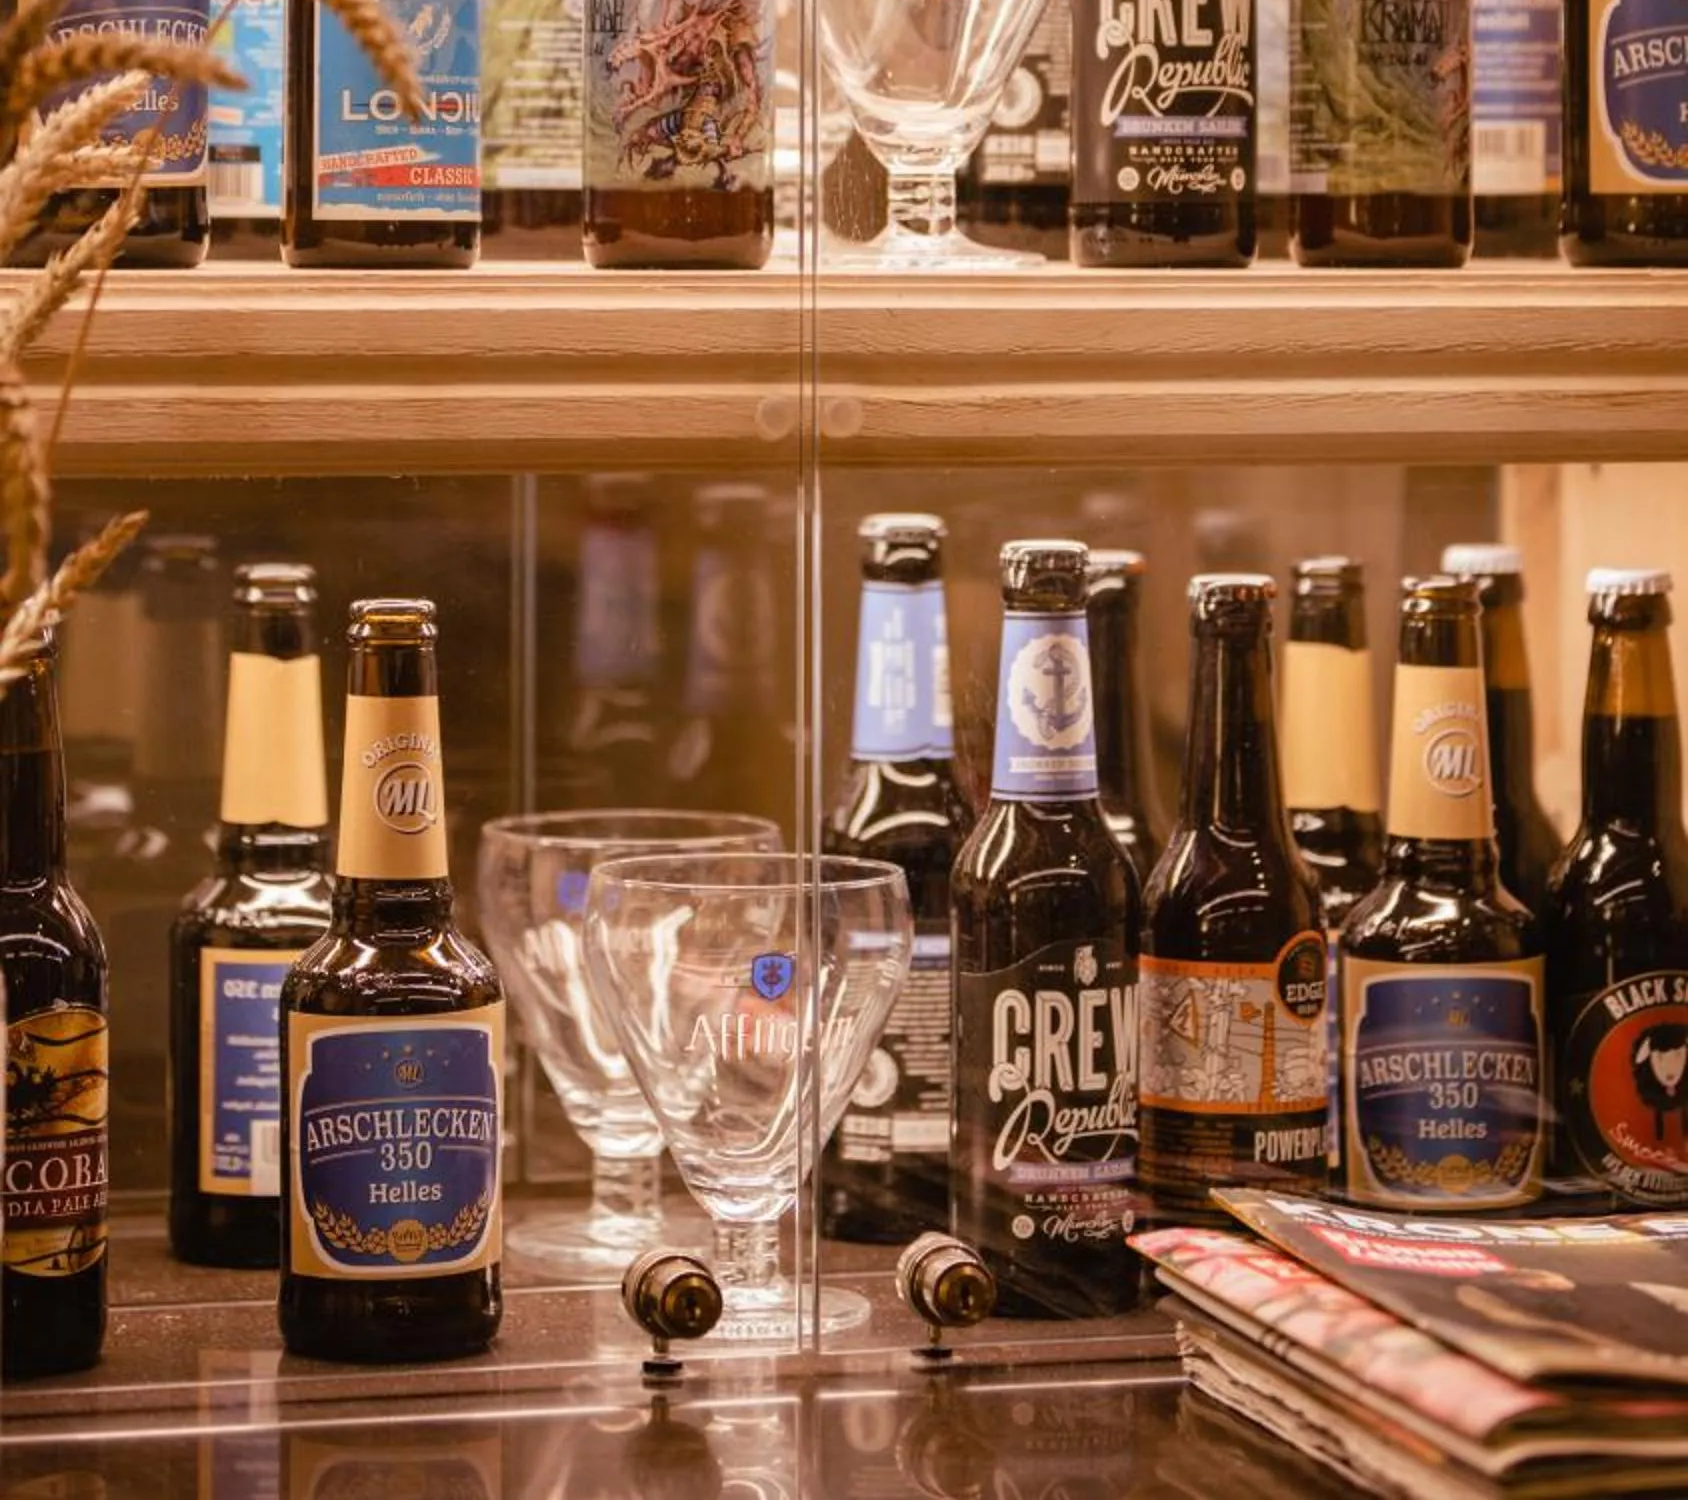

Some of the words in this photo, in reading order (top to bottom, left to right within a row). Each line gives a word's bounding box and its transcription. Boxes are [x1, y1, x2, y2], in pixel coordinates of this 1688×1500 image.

[1096, 19, 1254, 127] Republic
[124, 89, 180, 112] elles
[1604, 977, 1669, 1021] BLACK
[992, 984, 1140, 1091] CREW
[1359, 1050, 1537, 1089] ARSCHLECKEN
[1428, 1082, 1479, 1110] 350
[306, 1107, 495, 1153] ARSCHLECKEN
[1417, 1118, 1488, 1140] Helles
[380, 1140, 432, 1172] 350
[368, 1180, 443, 1204] Helles
